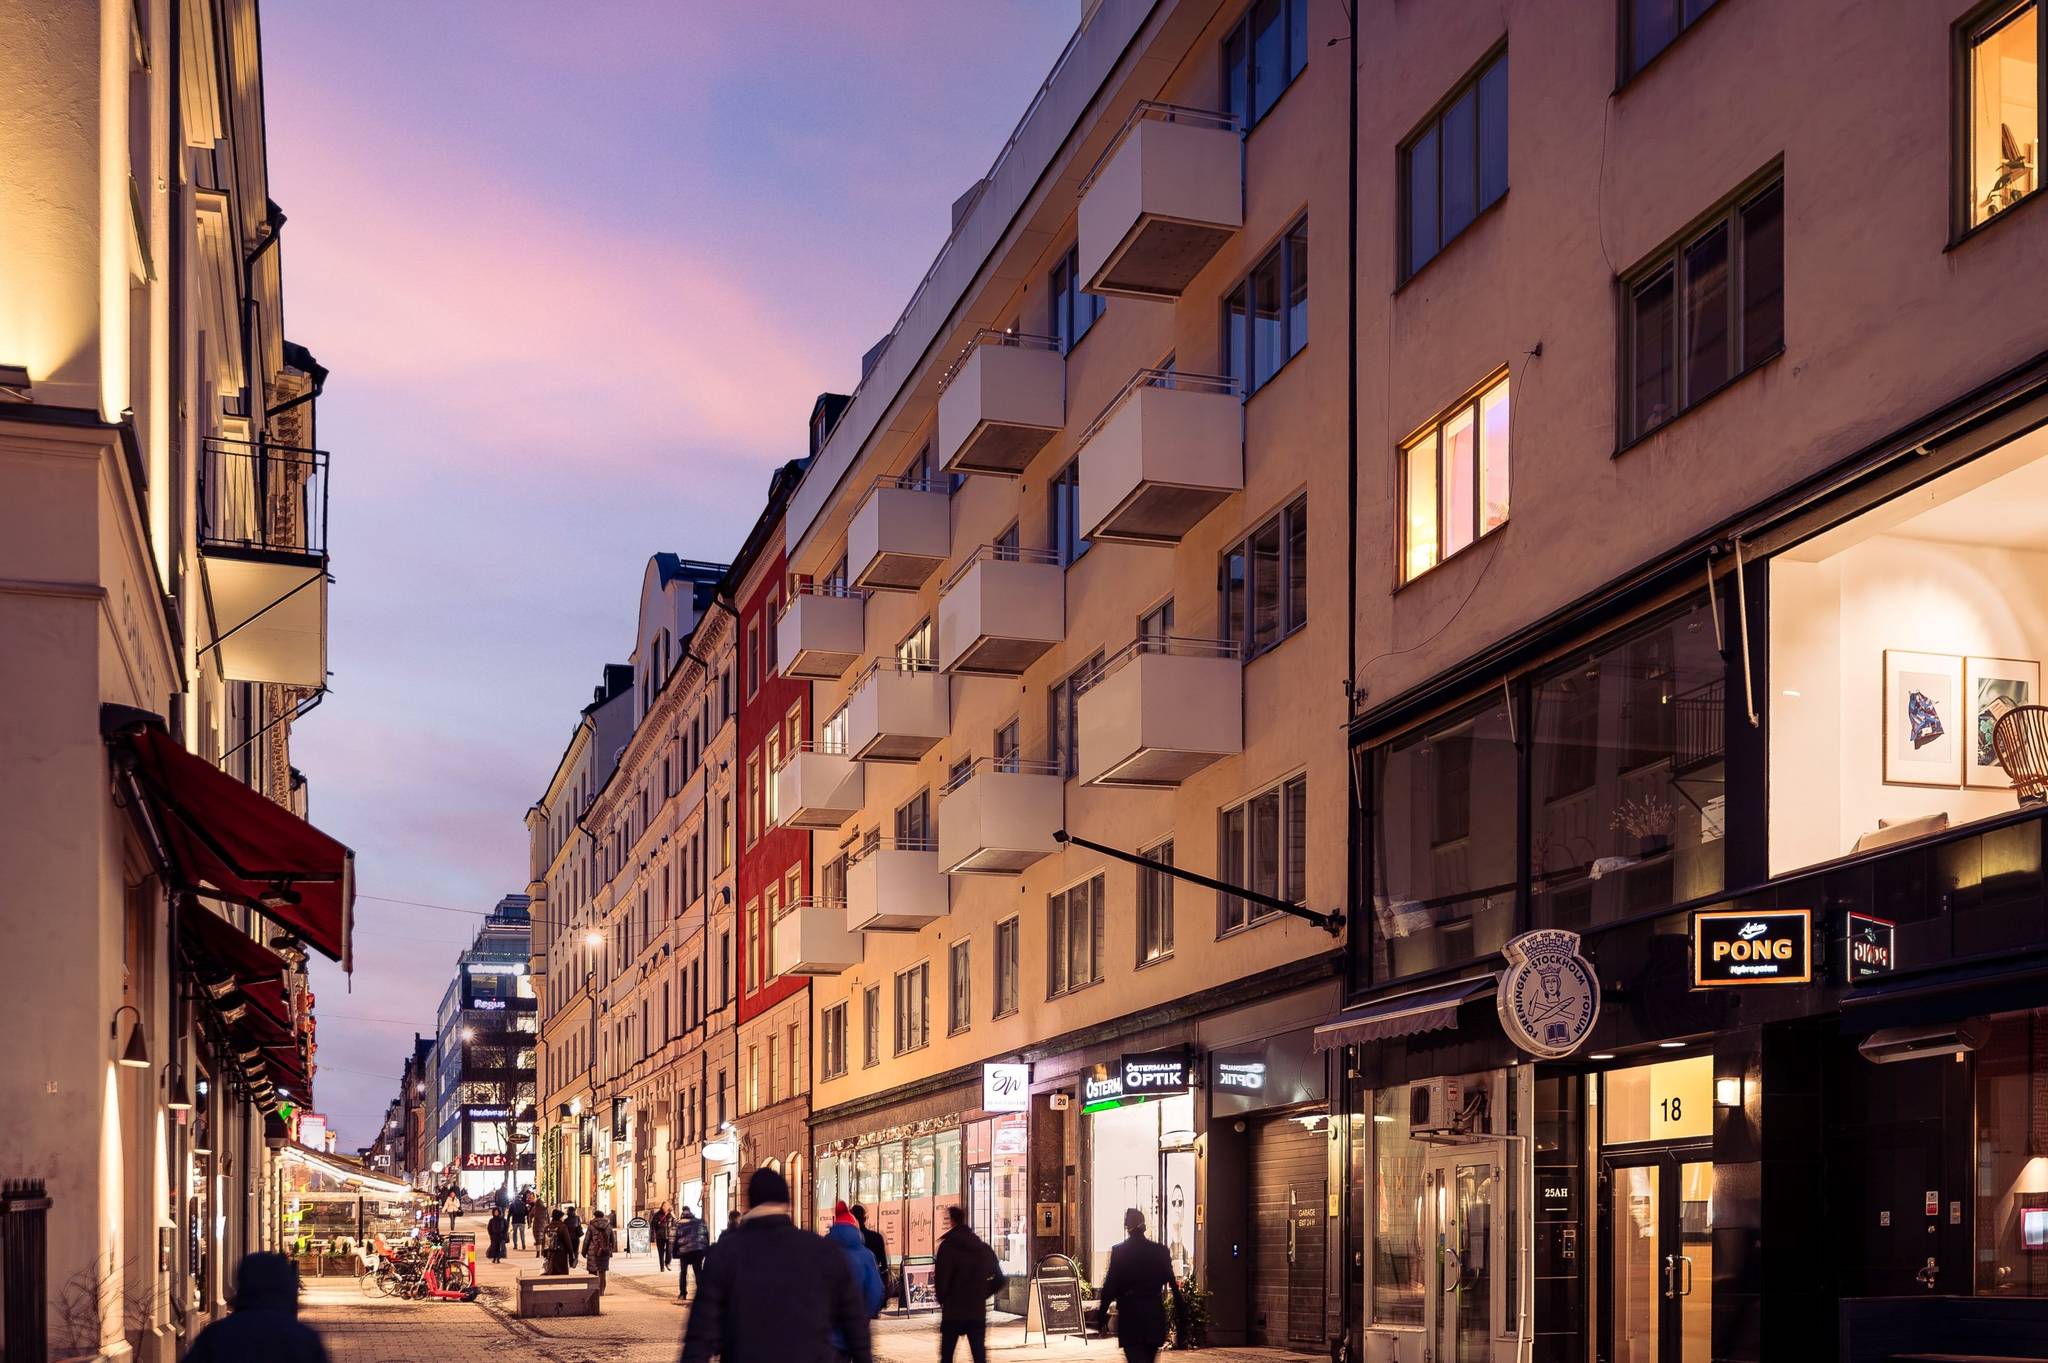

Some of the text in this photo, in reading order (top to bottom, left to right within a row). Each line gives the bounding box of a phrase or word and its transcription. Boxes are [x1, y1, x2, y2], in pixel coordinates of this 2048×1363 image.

[1713, 939, 1792, 961] PONG
[474, 998, 505, 1009] Regus
[1515, 955, 1590, 1039] FÖRENINGEN STOCKHOLM FORUM
[1126, 1063, 1182, 1072] ÖSTERMALMS
[1126, 1072, 1182, 1087] OPTIK
[1086, 1077, 1122, 1098] ÖSTERM
[1661, 1097, 1682, 1121] 18
[467, 1153, 507, 1166] ÅHLÉ
[1545, 1188, 1568, 1197] 25AH
